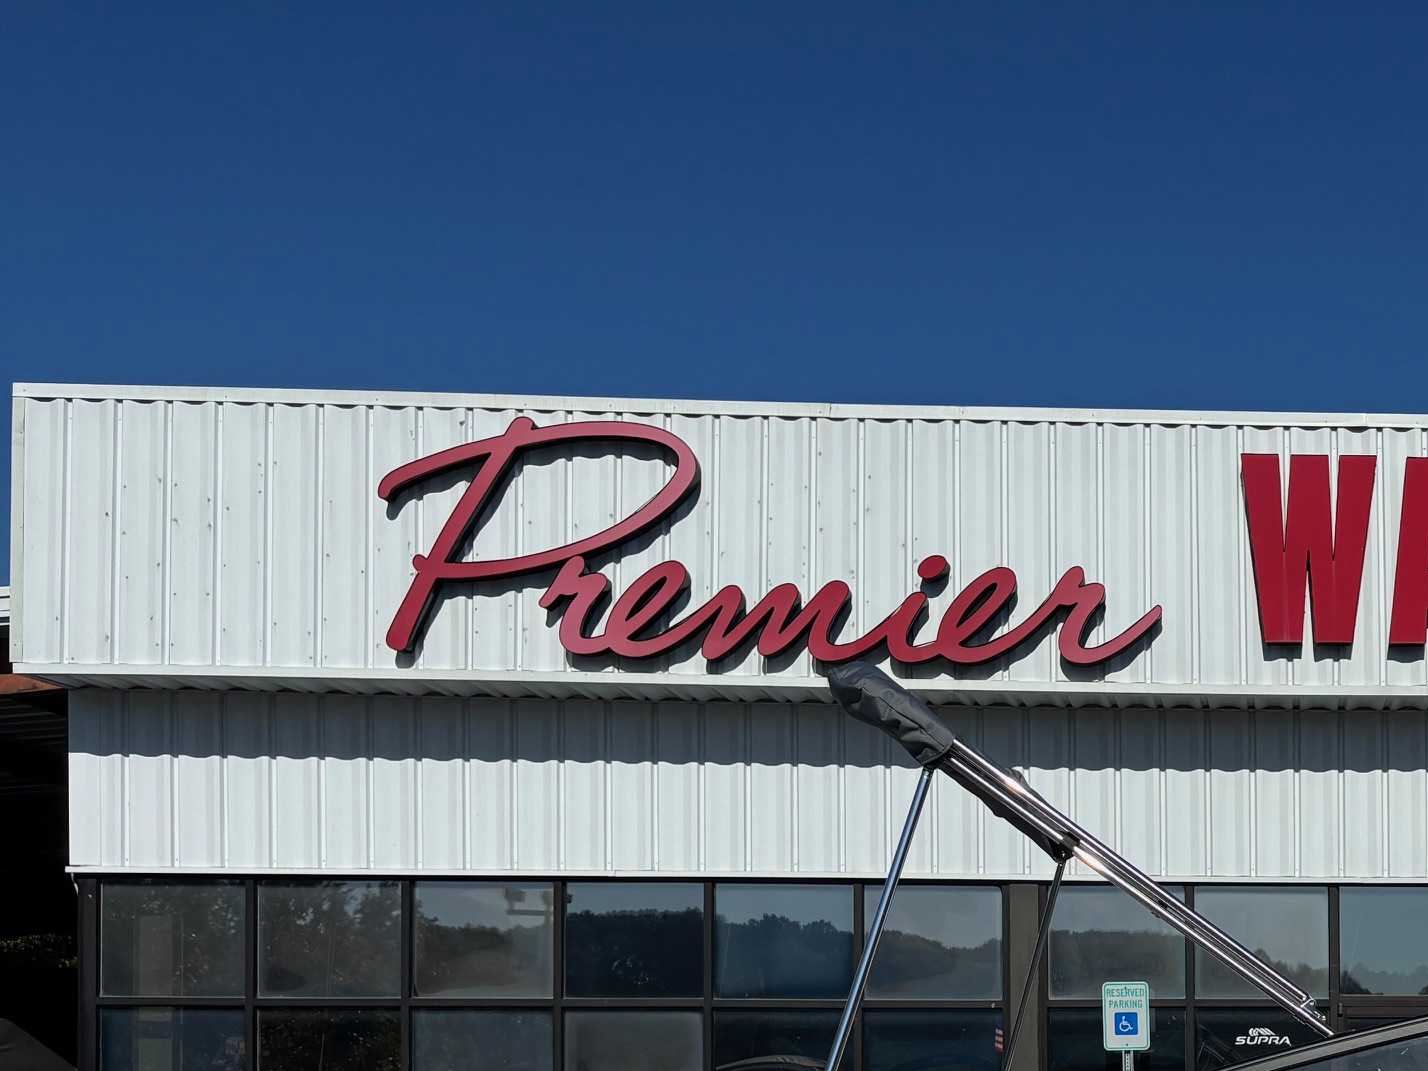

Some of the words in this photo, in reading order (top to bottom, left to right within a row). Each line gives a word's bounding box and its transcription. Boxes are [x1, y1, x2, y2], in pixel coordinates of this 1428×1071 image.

[379, 417, 1162, 665] Premier
[1106, 988, 1145, 999] RESERVED
[1109, 1000, 1143, 1009] PARKING
[1234, 1035, 1292, 1047] SUPRA
